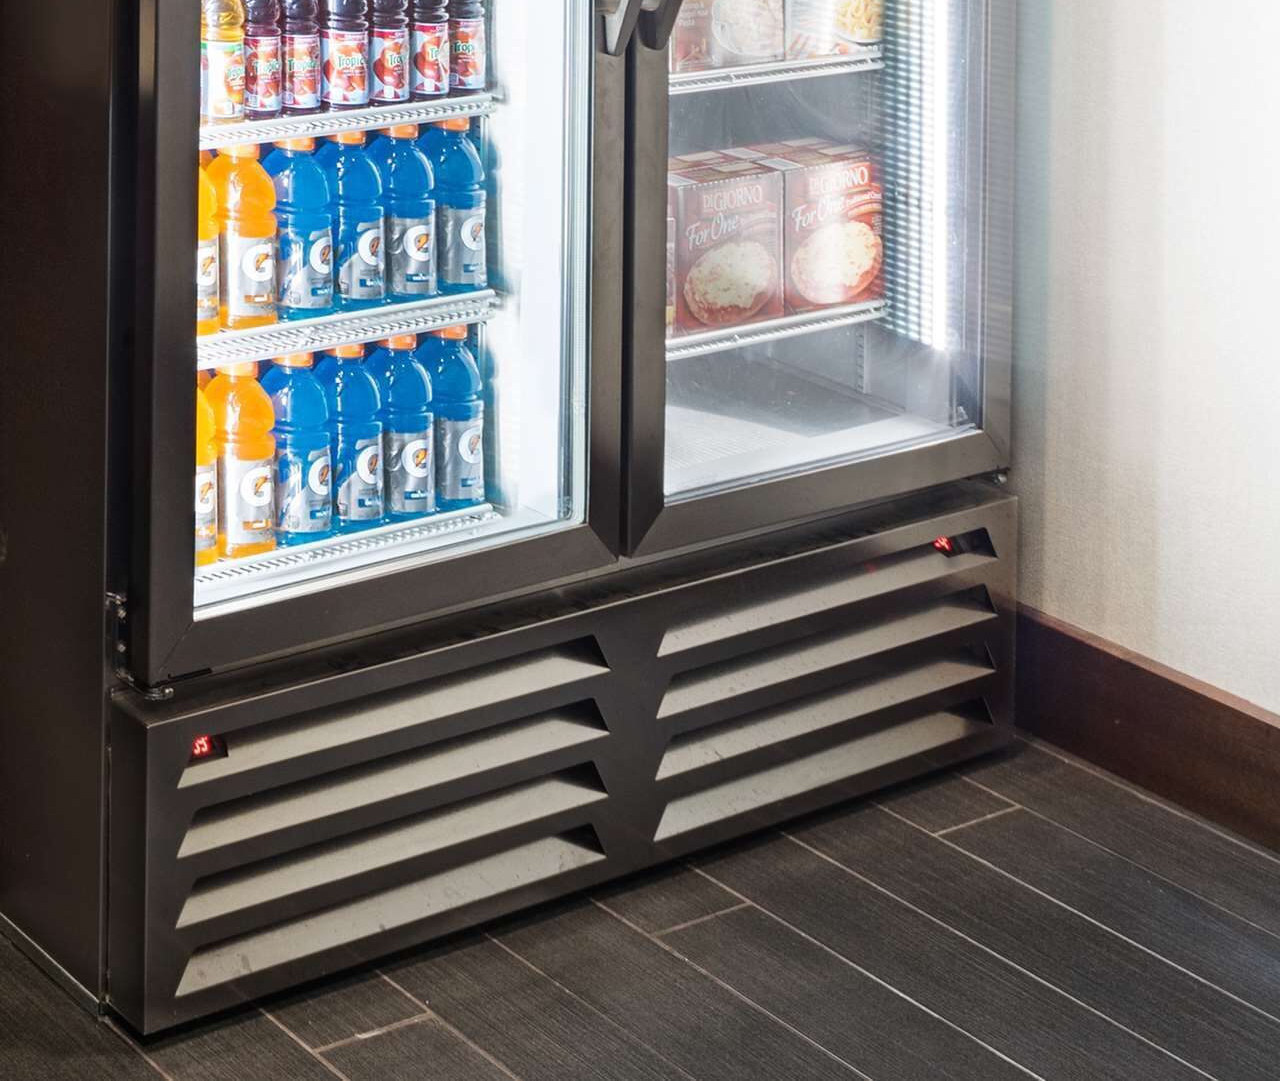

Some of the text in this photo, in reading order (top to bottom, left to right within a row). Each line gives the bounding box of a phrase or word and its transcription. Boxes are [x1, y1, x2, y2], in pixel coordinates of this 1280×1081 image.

[686, 212, 738, 250] For One
[791, 203, 816, 232] For
